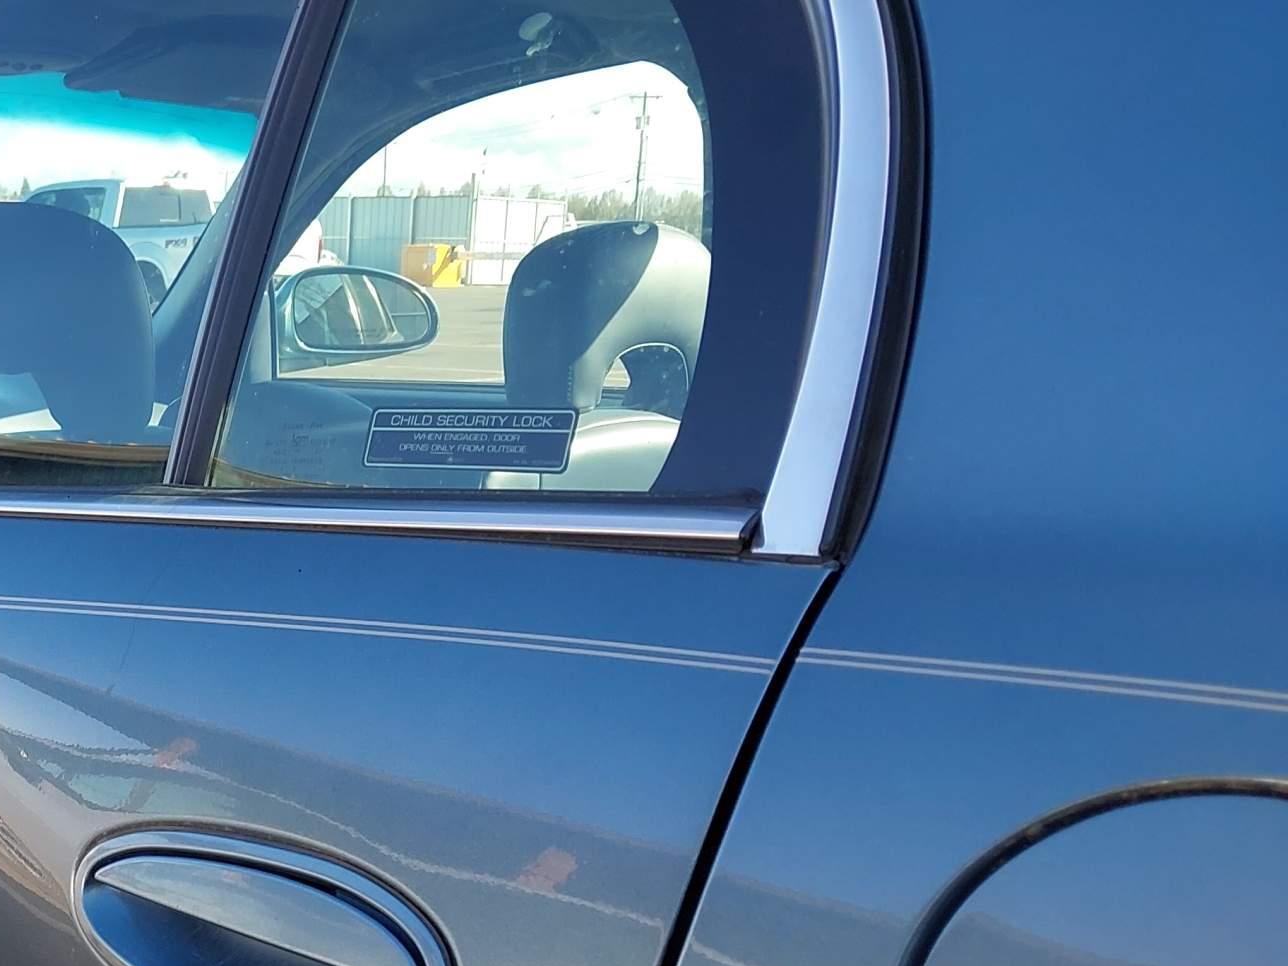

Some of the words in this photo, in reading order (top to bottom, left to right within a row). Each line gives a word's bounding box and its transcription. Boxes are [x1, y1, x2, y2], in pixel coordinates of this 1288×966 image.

[390, 414, 433, 427] CHILD
[436, 414, 509, 428] SECURITY
[512, 415, 553, 428] LOCK
[413, 432, 443, 441] WHEN
[493, 433, 520, 442] DOOR
[398, 443, 429, 452] OPENS
[430, 443, 455, 453] ONLY
[455, 444, 485, 453] FROM
